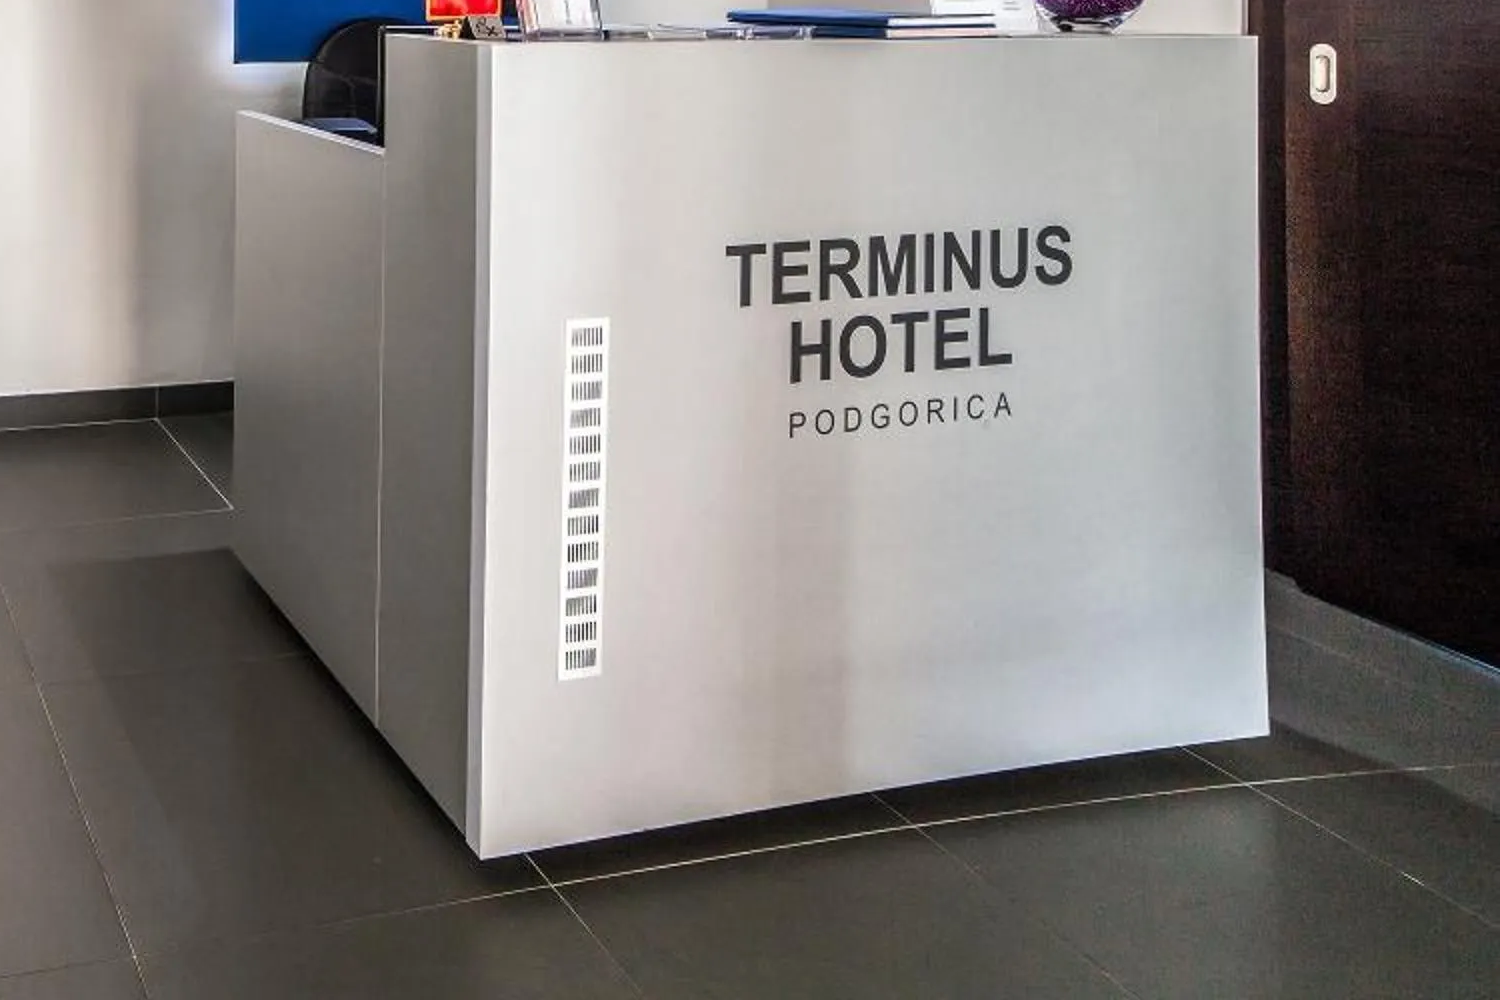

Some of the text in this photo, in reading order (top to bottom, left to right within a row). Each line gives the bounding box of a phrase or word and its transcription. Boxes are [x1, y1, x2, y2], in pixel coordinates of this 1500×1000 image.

[726, 225, 1072, 307] TERMINUS
[789, 307, 1012, 383] HOTEL
[788, 392, 1012, 438] PODGORICA
